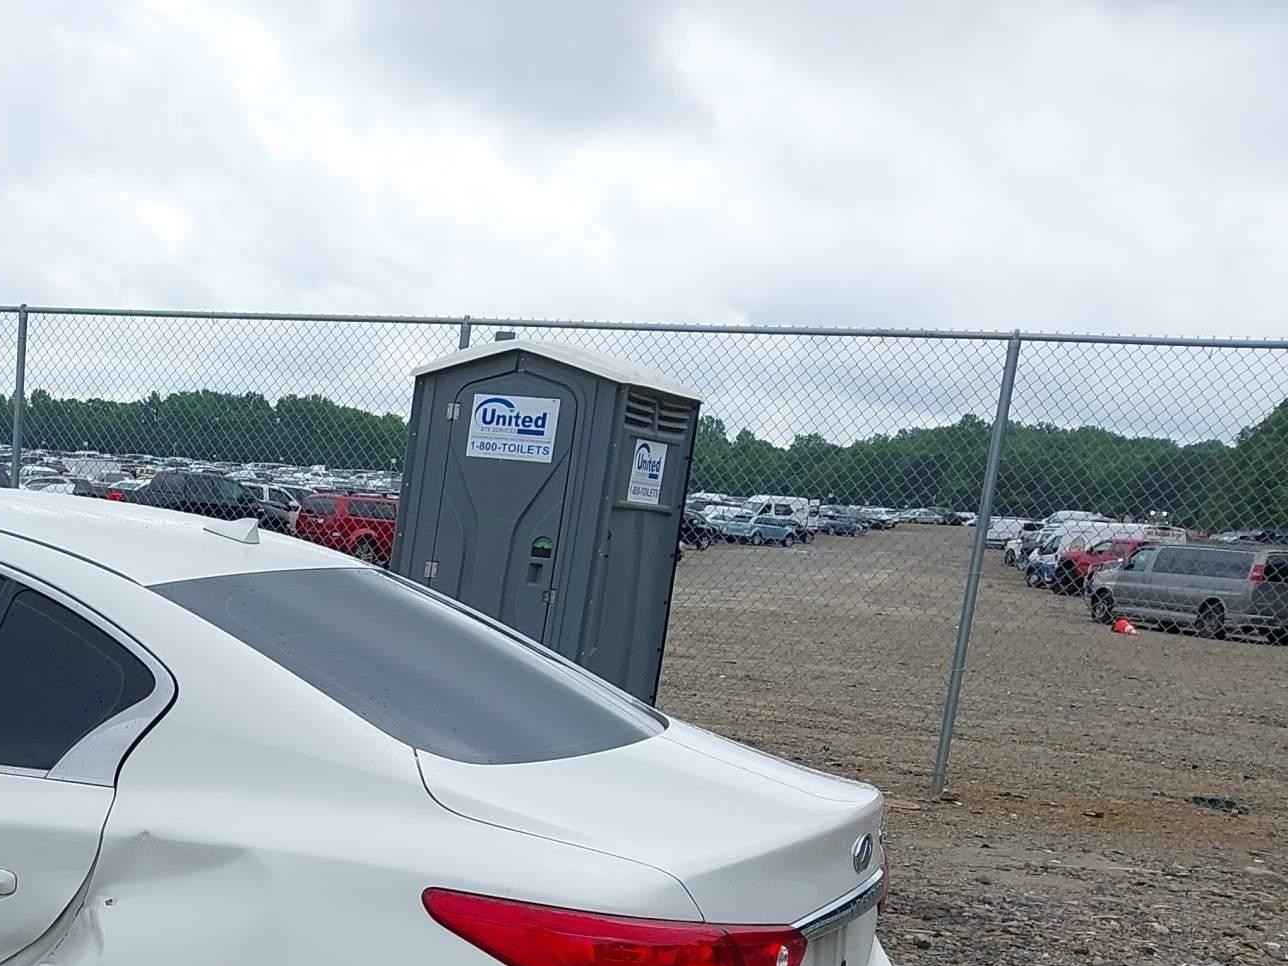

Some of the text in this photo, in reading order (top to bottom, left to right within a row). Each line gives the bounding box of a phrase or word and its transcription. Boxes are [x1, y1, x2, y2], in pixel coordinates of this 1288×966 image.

[482, 407, 548, 429] United
[470, 441, 550, 456] 1-800-TOILETS
[637, 453, 662, 473] United
